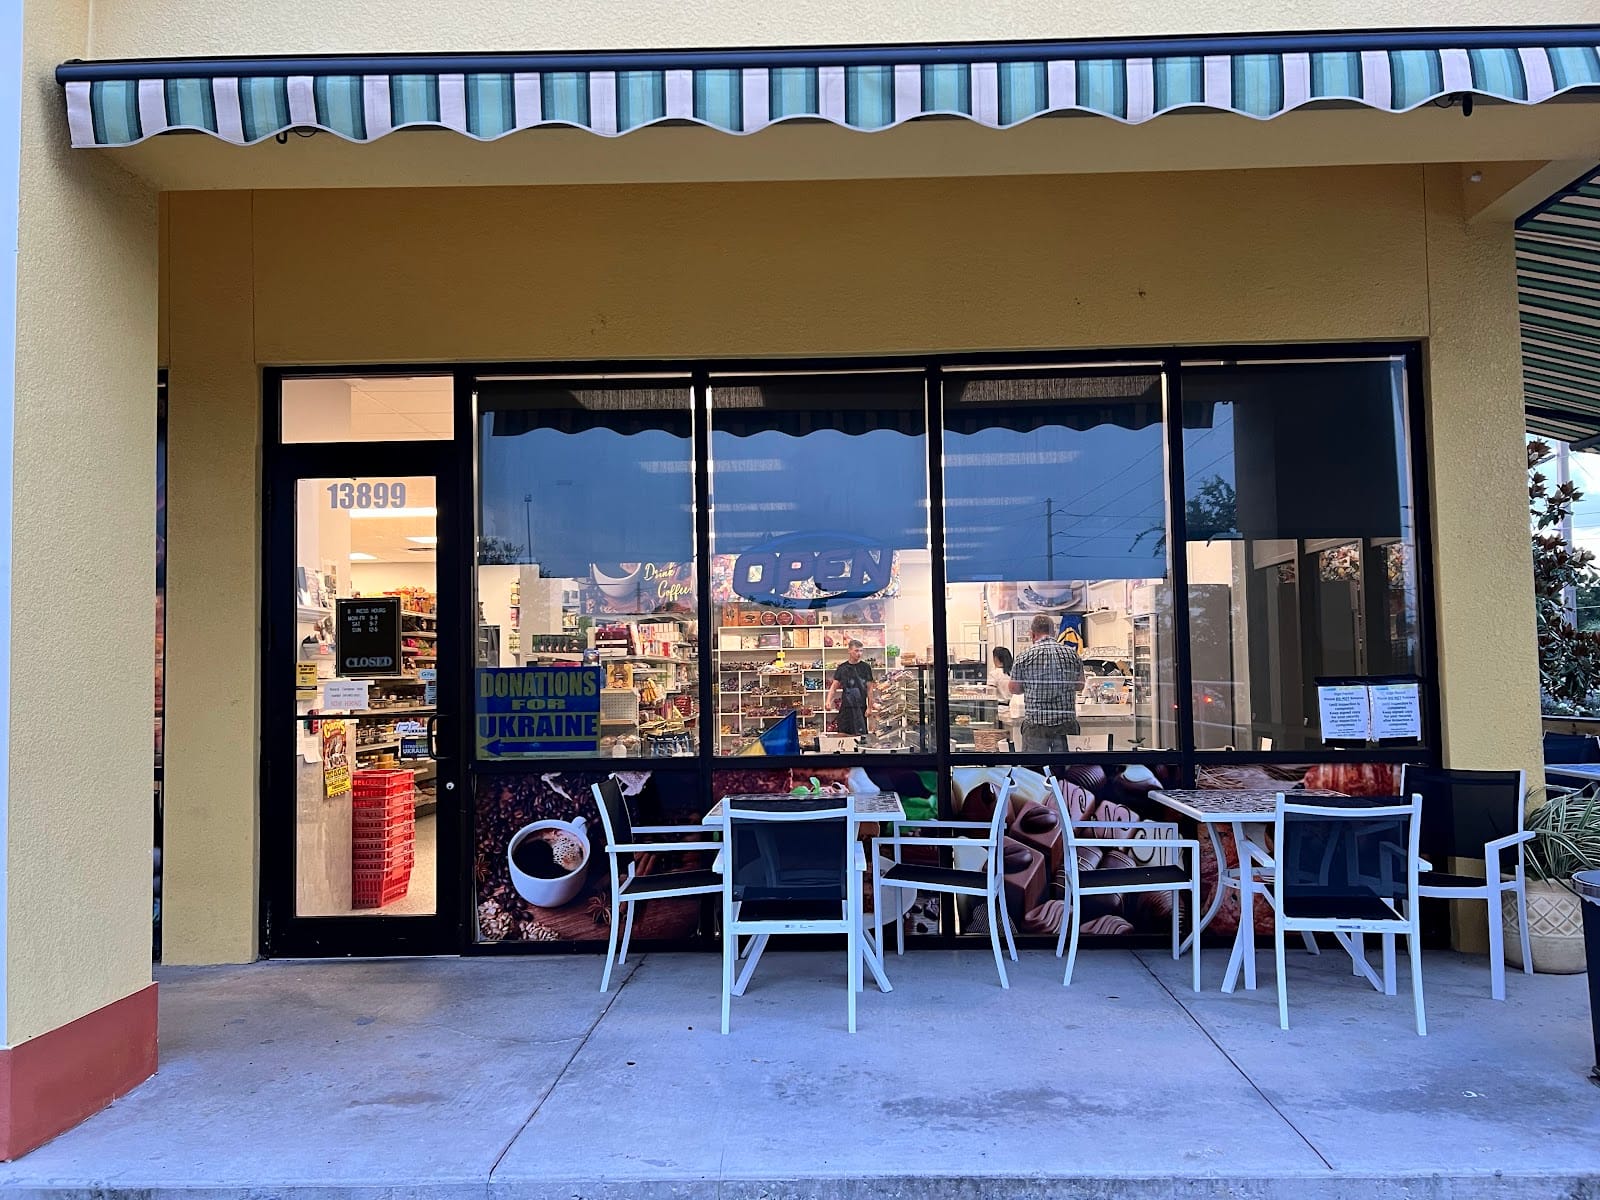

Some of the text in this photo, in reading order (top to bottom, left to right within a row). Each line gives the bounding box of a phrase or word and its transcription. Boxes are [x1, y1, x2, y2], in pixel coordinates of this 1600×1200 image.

[327, 482, 406, 509] 13899
[643, 561, 675, 580] Drink
[733, 548, 893, 595] OPEN
[345, 656, 393, 668] CLOSED
[480, 671, 596, 698] DONATIONS
[511, 698, 566, 710] FOR
[479, 714, 598, 738] UKRAINE
